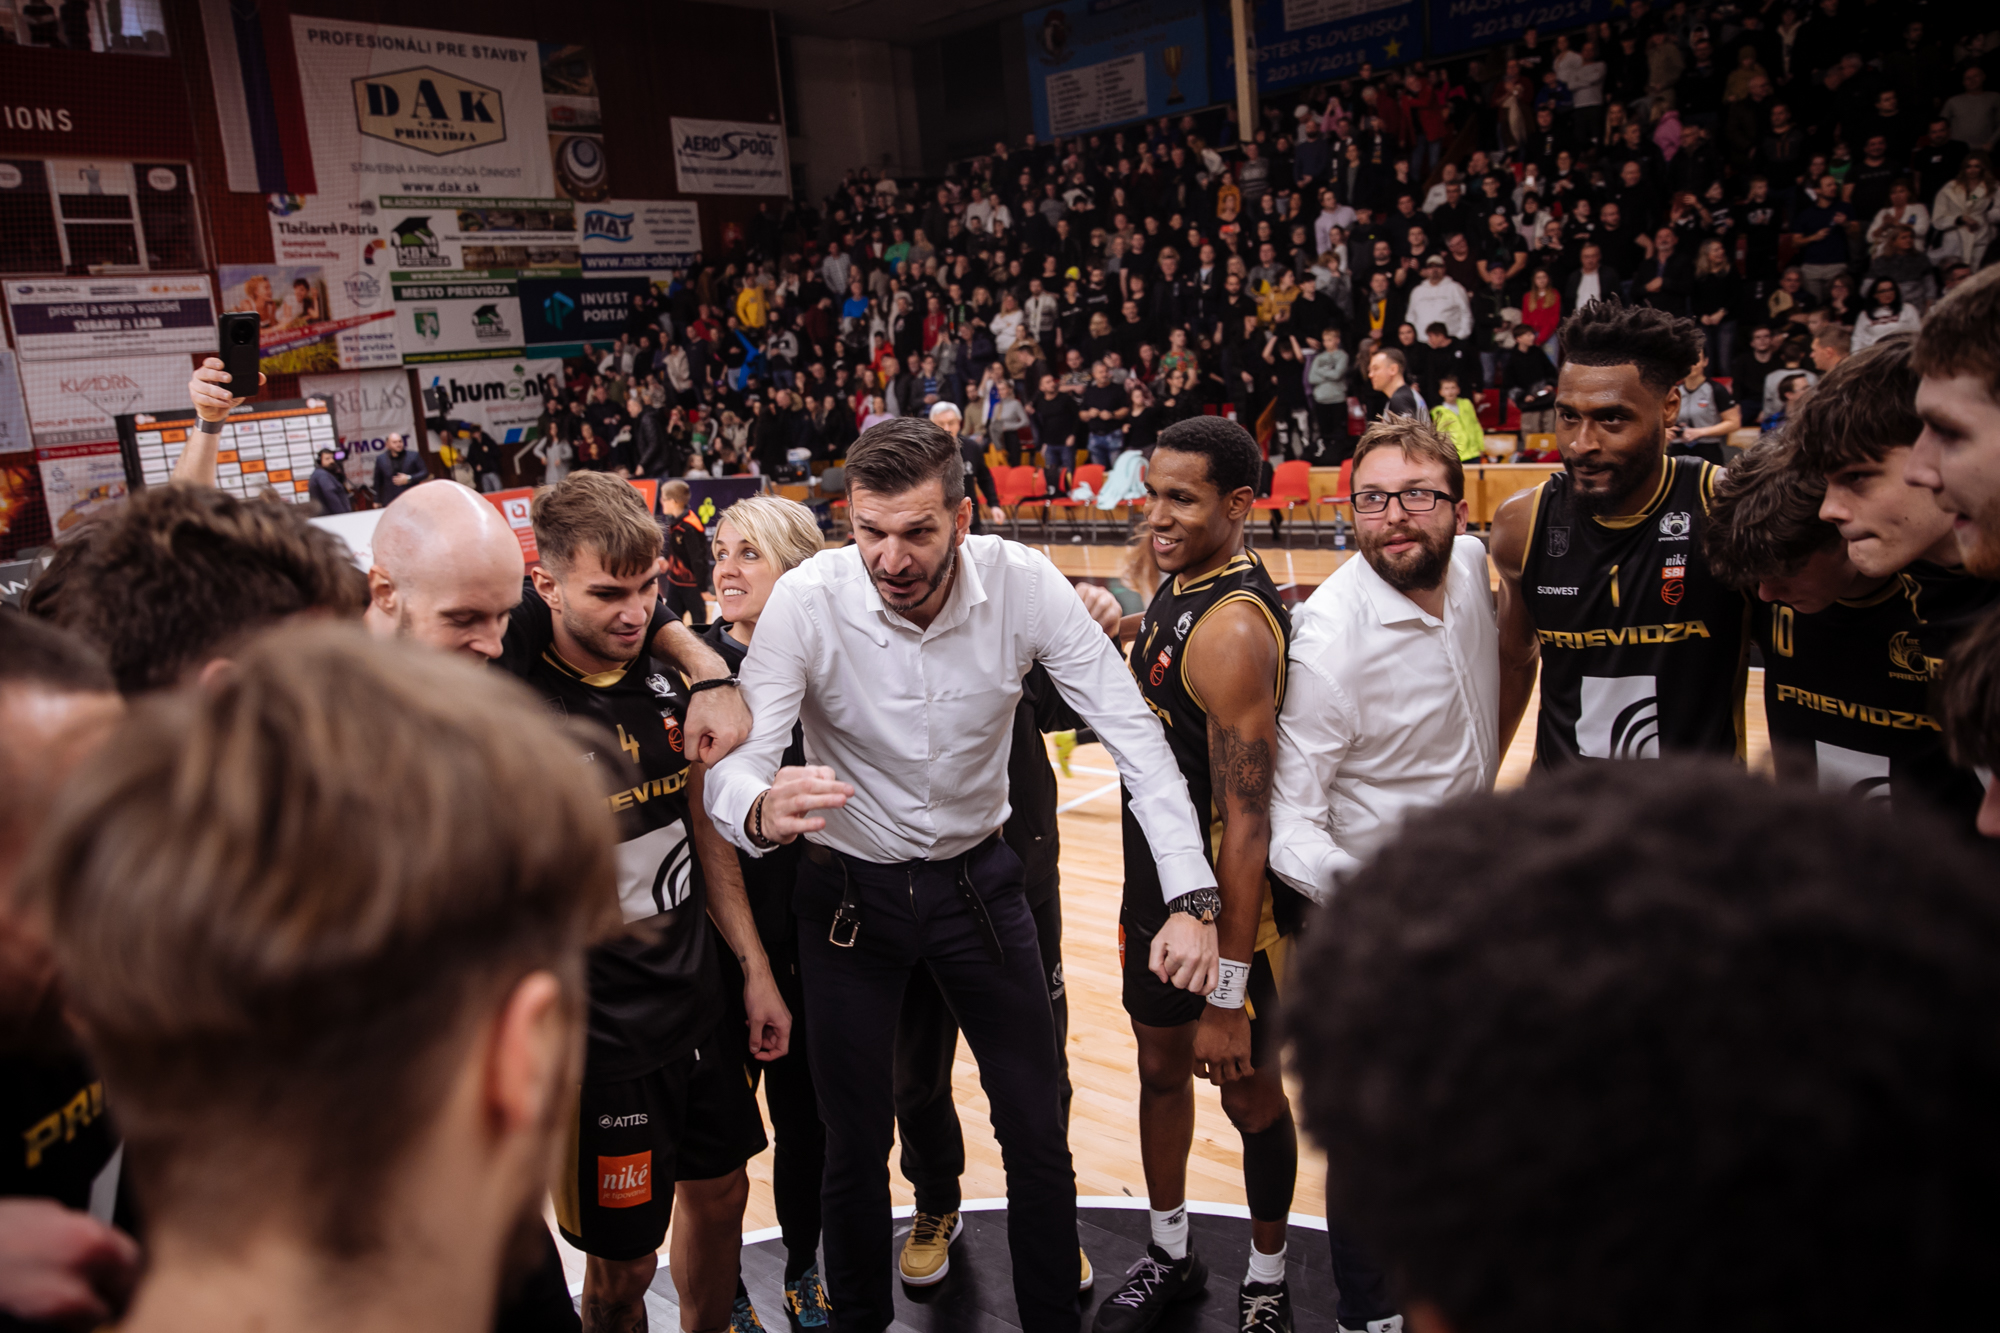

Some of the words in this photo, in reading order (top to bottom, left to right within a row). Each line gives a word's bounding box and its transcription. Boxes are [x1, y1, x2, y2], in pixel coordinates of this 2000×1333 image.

[1305, 13, 1410, 52] SLOVENSKA
[1471, 2, 1593, 38] 2018/2019
[308, 28, 432, 54] PROFESIONÁLI
[437, 41, 467, 57] PRE
[472, 45, 528, 63] STAVBY
[1266, 49, 1367, 83] 2017/2018
[365, 78, 495, 123] DAK
[395, 127, 477, 142] PRIEVIDZA
[402, 180, 481, 194] www.dak.sk
[277, 221, 338, 235] Tlačiareň
[340, 222, 379, 235] Patria
[584, 214, 633, 237] MAT
[586, 254, 695, 270] www.mat-obaly.s
[401, 286, 444, 299] MESTO
[447, 284, 510, 297] PRIEVIDZA
[581, 291, 629, 305] INVEST
[47, 303, 89, 319] predaj
[73, 318, 121, 332] SUBARU
[133, 317, 163, 329] LADA
[493, 416, 538, 426] www.hum
[340, 435, 410, 454] VMOT
[1609, 564, 1620, 608] 1
[1536, 620, 1711, 649] PRIEVIDZA
[1771, 603, 1794, 658] 10
[1888, 671, 1928, 682] PRIEVI
[1776, 683, 1943, 732] PRIEVIDZA
[616, 723, 640, 764] 4
[609, 762, 692, 813] EVIDZ
[22, 1079, 103, 1169] PRI
[613, 1113, 648, 1128] ATTIS
[603, 1163, 648, 1190] niké
